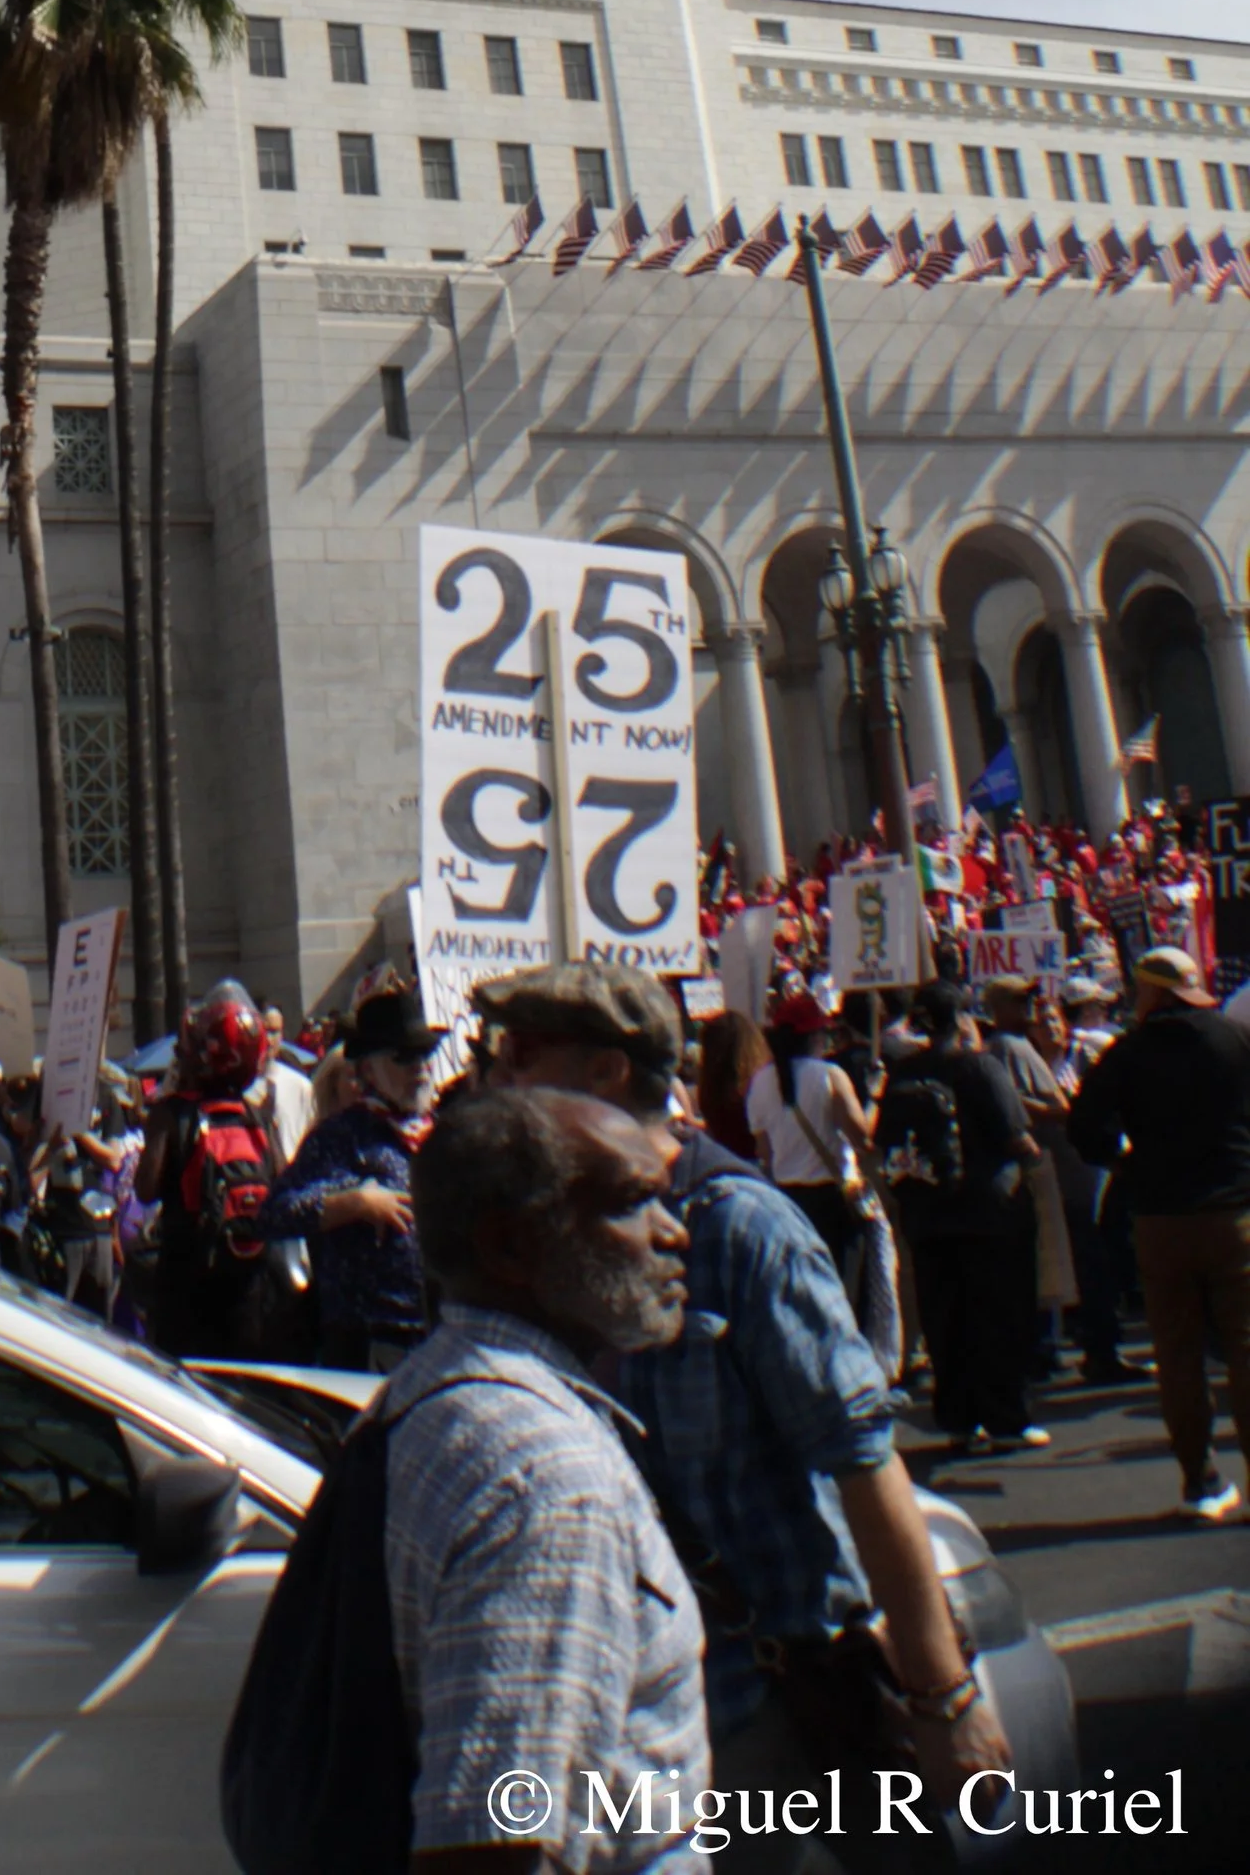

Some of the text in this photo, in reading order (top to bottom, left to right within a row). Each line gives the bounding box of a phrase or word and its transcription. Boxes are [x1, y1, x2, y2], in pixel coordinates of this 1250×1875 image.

[73, 928, 91, 967] E
[426, 928, 695, 969] AMENDMENT NOW!
[973, 936, 1060, 974] ARE WE
